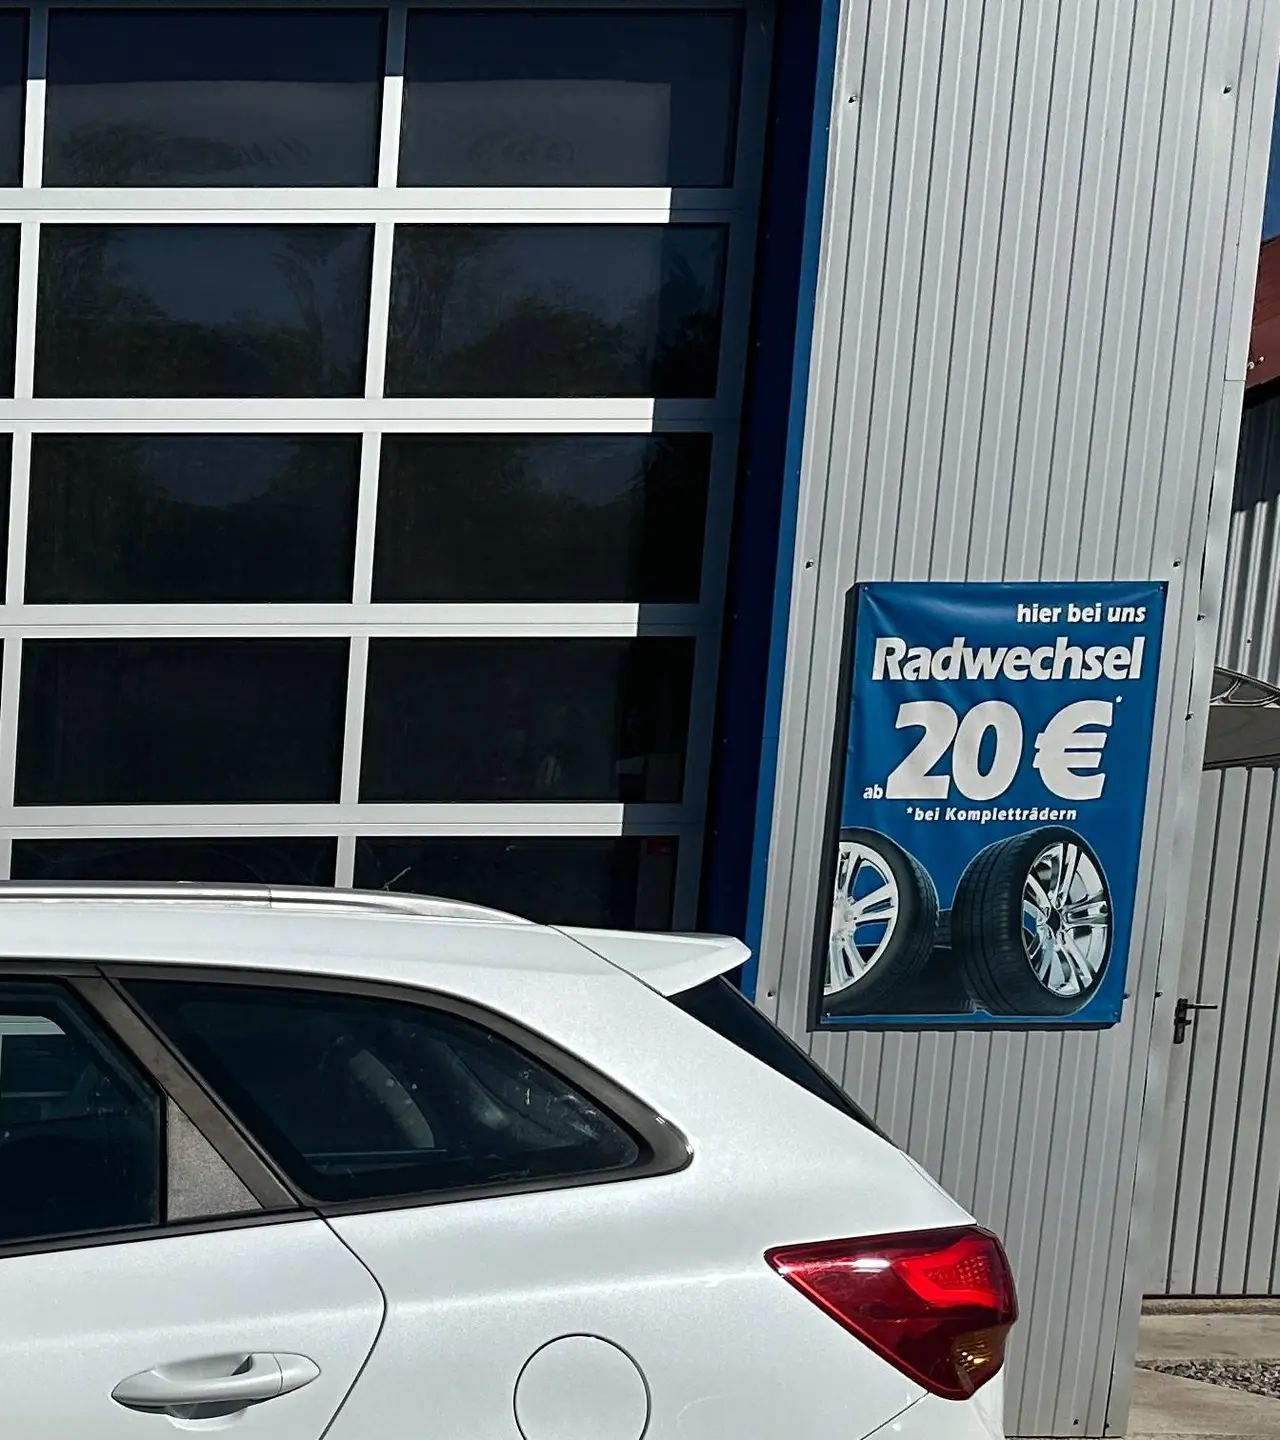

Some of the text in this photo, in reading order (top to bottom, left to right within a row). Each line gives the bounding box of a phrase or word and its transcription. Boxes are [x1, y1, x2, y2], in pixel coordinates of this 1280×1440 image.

[1016, 603, 1147, 623] hier bei uns
[871, 636, 1146, 681] Radwechsel
[863, 784, 884, 800] ab
[885, 700, 1023, 801] 20
[945, 807, 1077, 824] Kompletträdern
